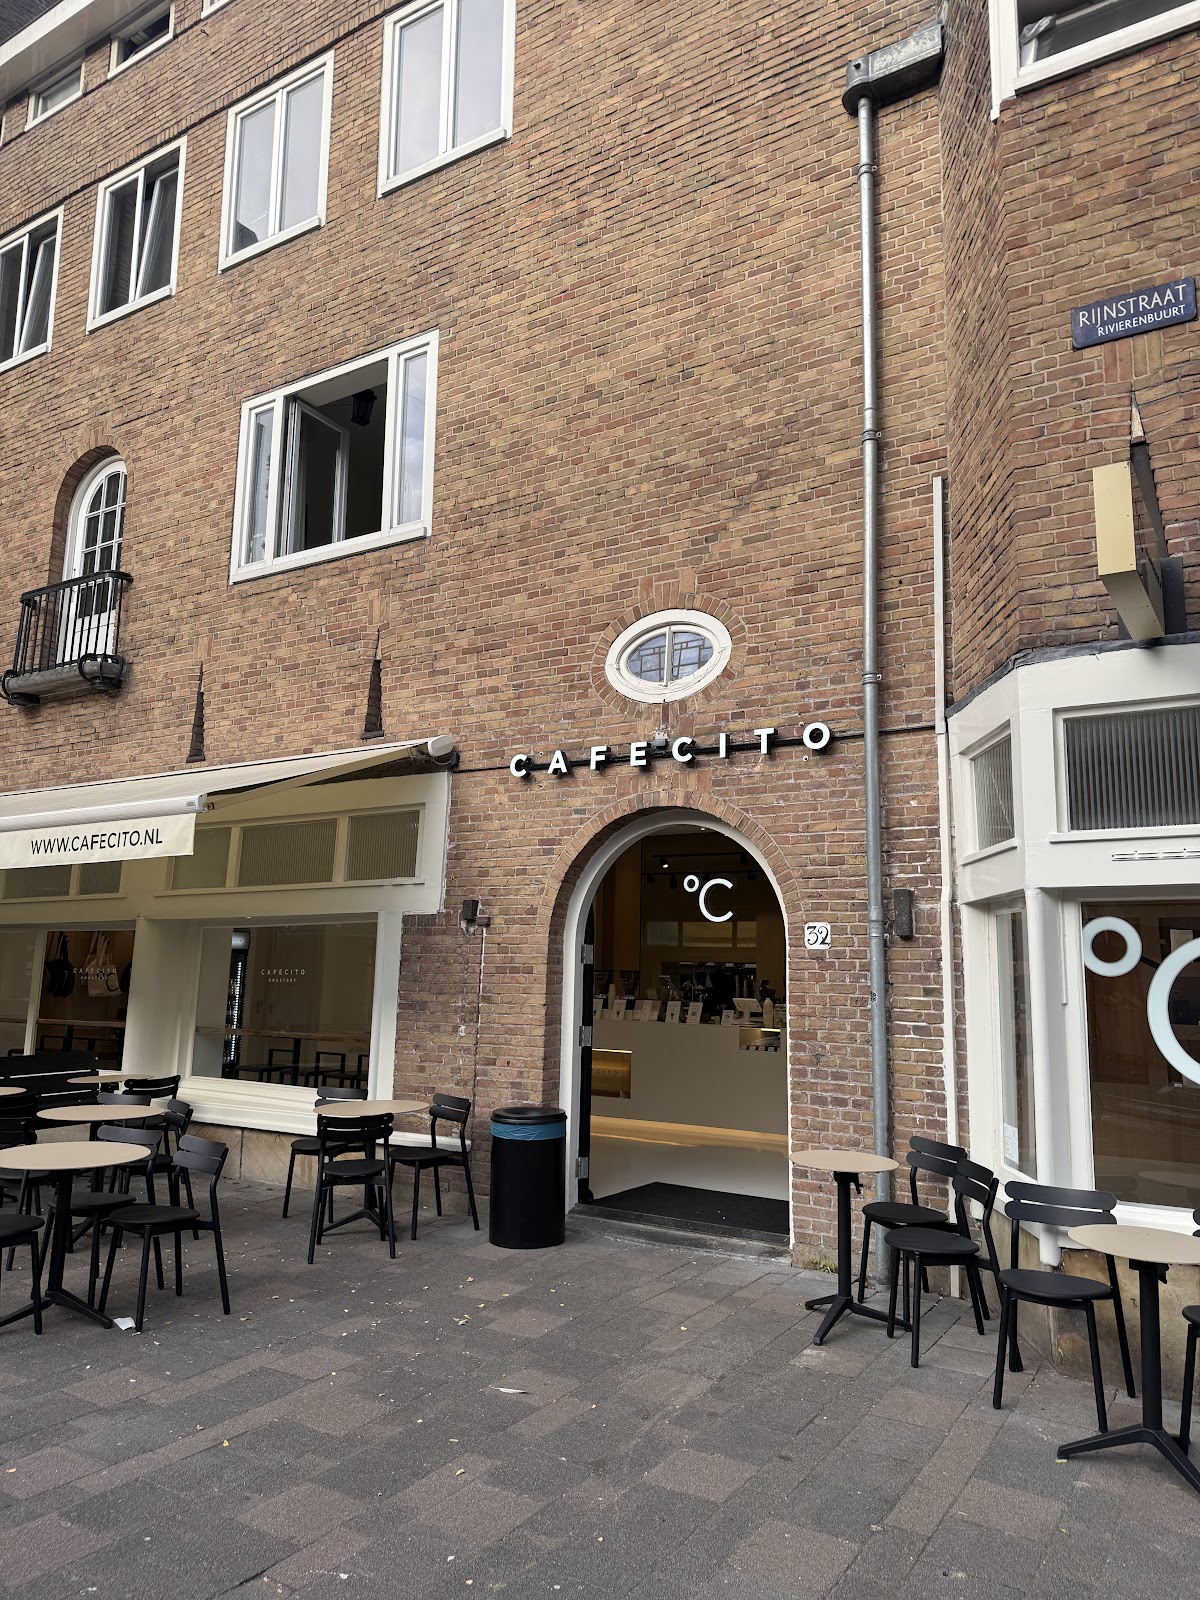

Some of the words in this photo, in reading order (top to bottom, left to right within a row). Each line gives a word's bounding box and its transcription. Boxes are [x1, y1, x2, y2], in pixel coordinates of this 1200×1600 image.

[1079, 284, 1187, 328] RIJNSTRAAT
[1098, 304, 1186, 337] RIVIERENBUURT
[509, 722, 831, 777] CAFECITO
[30, 828, 163, 855] WWW.CAFECITO.NL
[806, 925, 831, 946] 32
